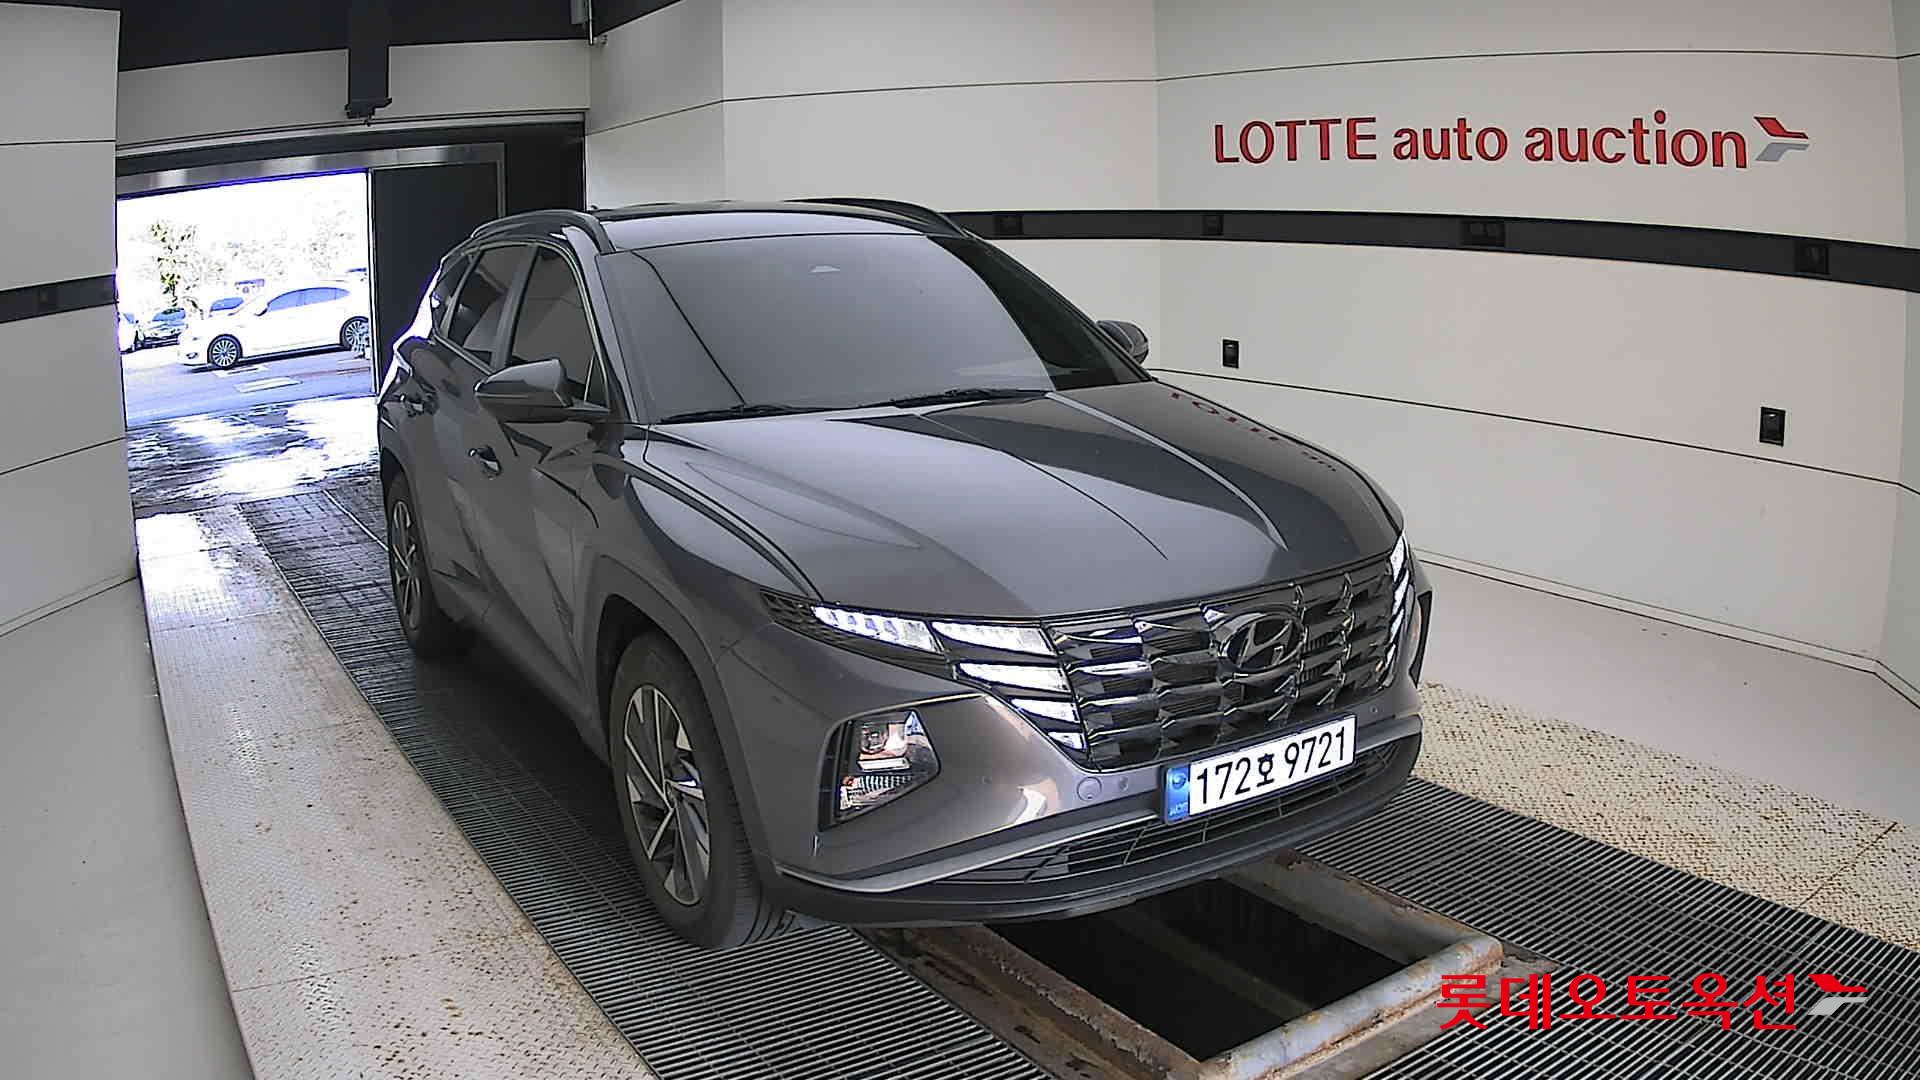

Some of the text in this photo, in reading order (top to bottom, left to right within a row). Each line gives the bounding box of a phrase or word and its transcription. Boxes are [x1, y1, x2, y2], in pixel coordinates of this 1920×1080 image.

[1214, 110, 1748, 169] LOTTE auto auction
[1284, 726, 1345, 778] 9721
